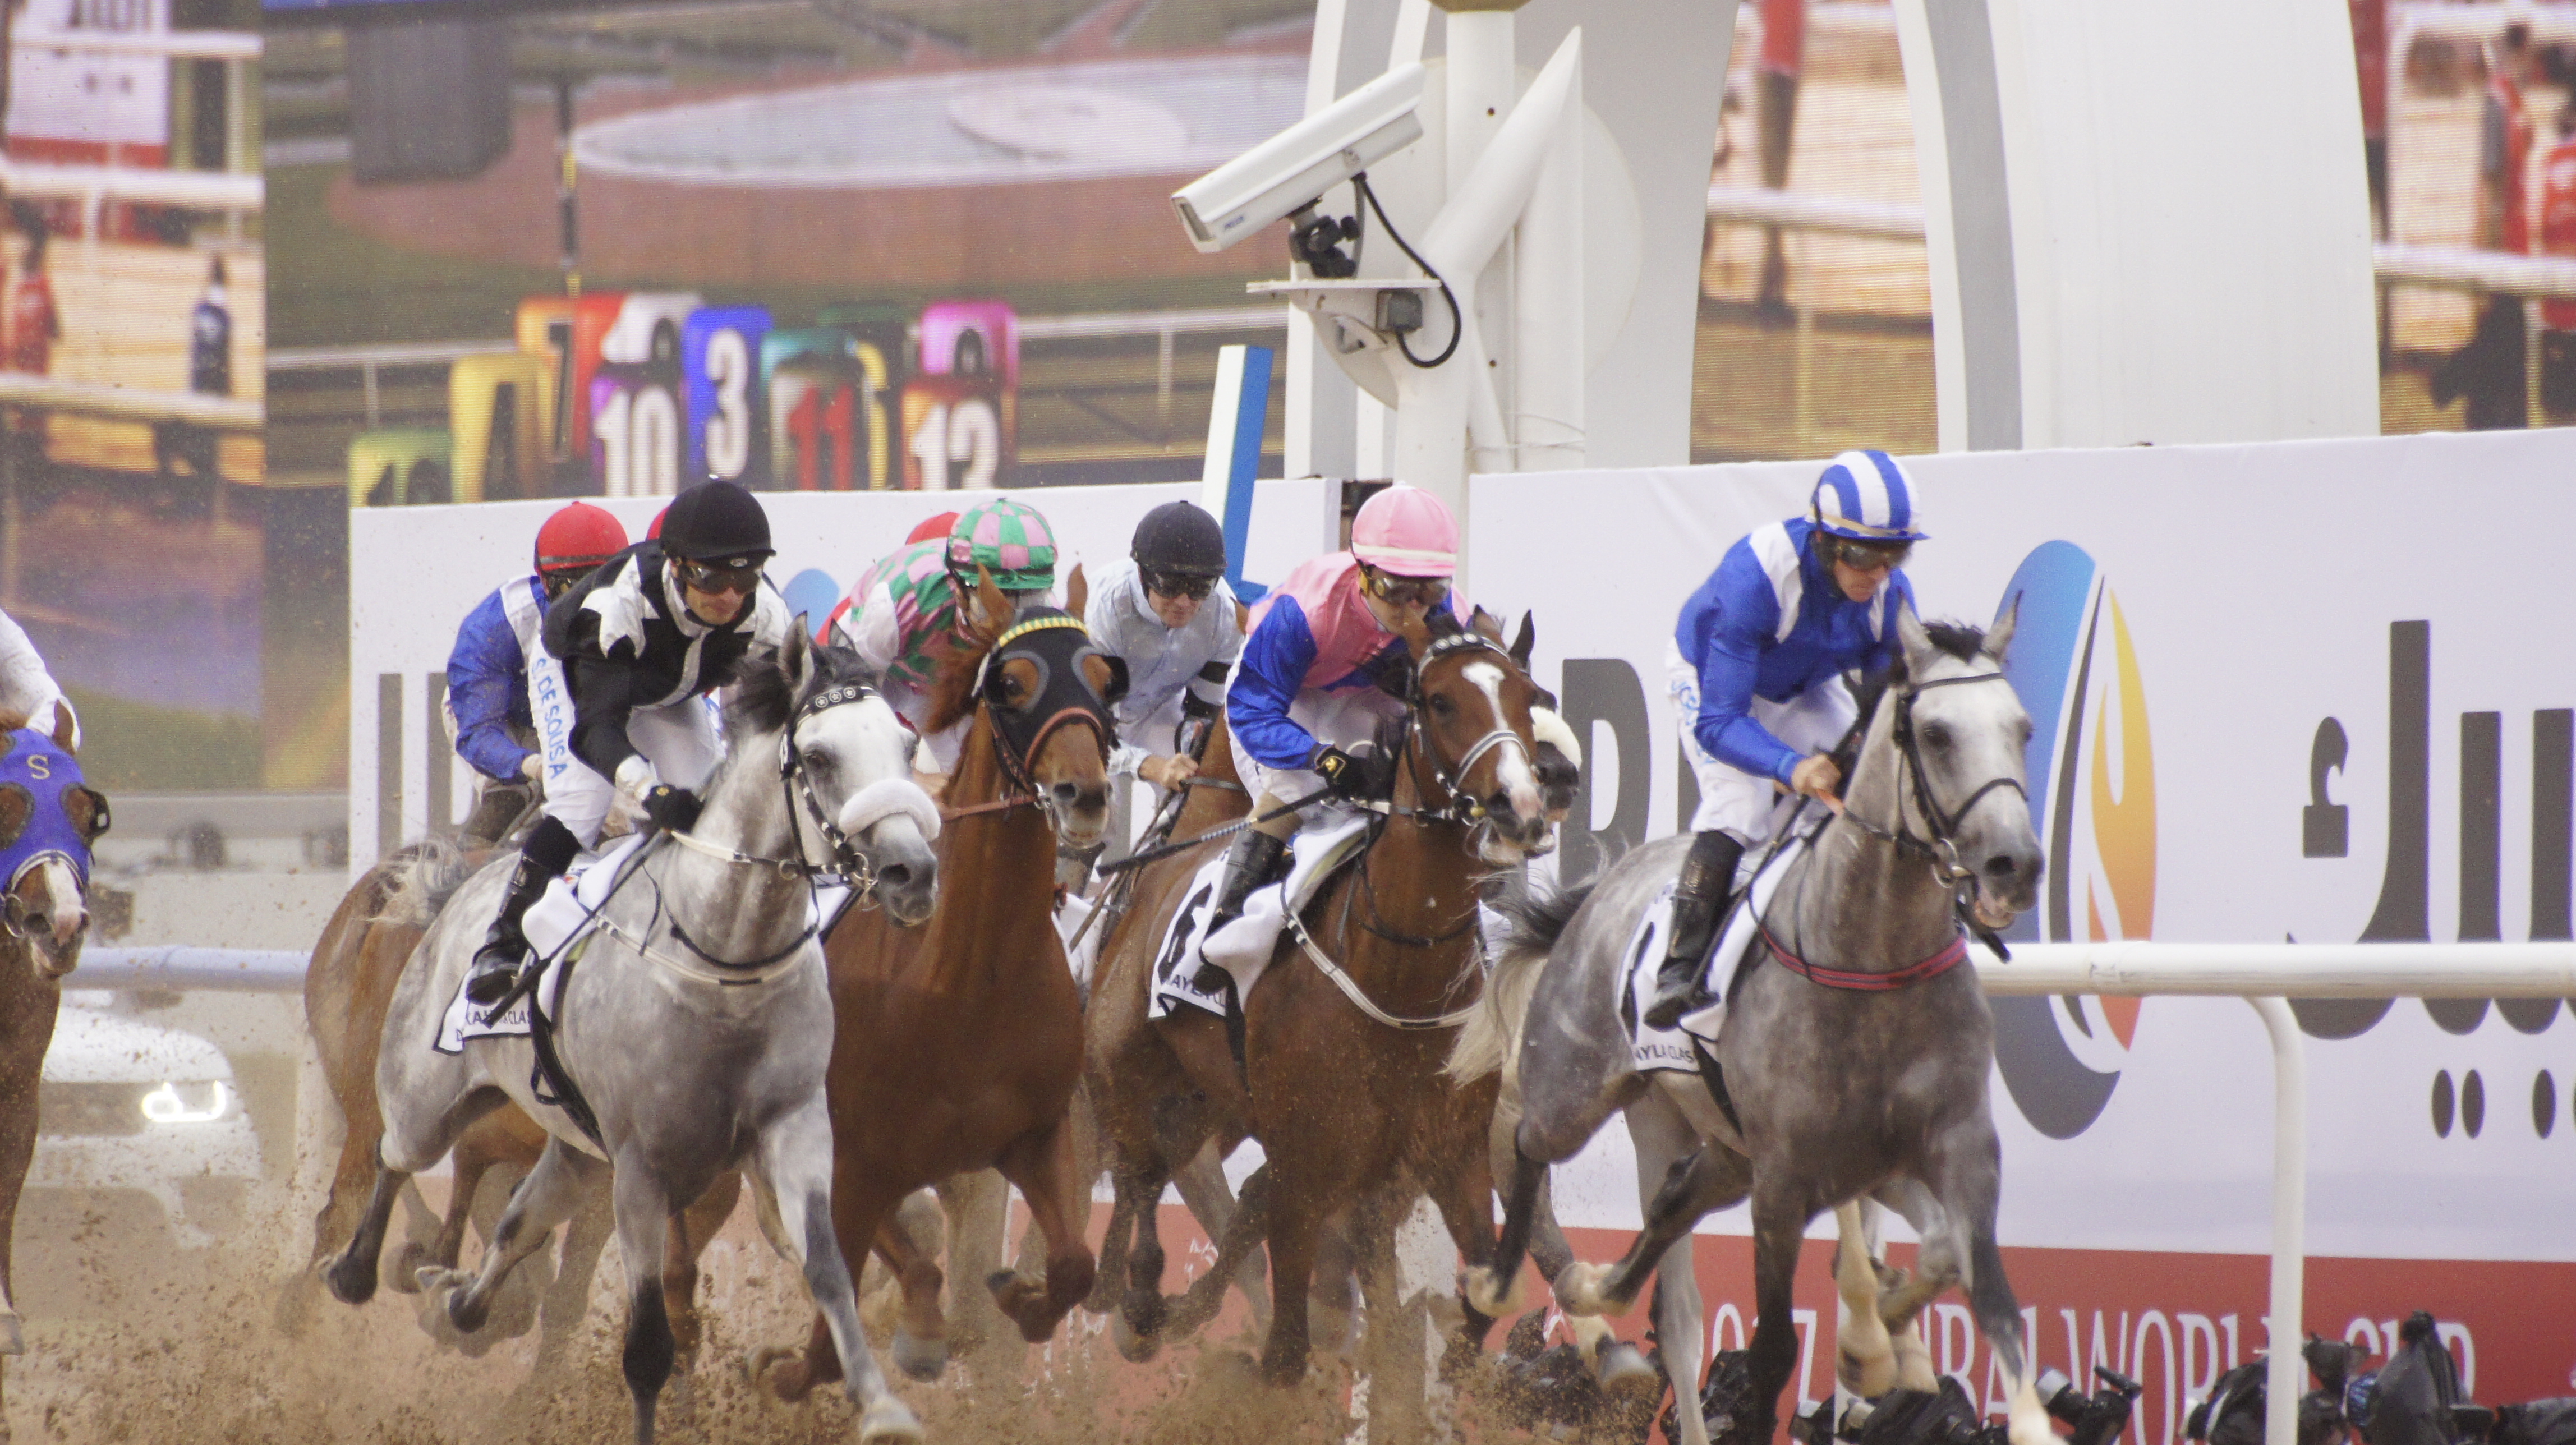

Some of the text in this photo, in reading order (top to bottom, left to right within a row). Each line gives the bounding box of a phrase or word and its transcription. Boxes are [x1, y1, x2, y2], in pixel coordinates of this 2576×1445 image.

[705, 326, 749, 478] 3
[537, 675, 556, 706] DE
[27, 754, 50, 780] S
[544, 705, 568, 779] SOUSA
[2060, 1309, 2310, 1445] WOR
